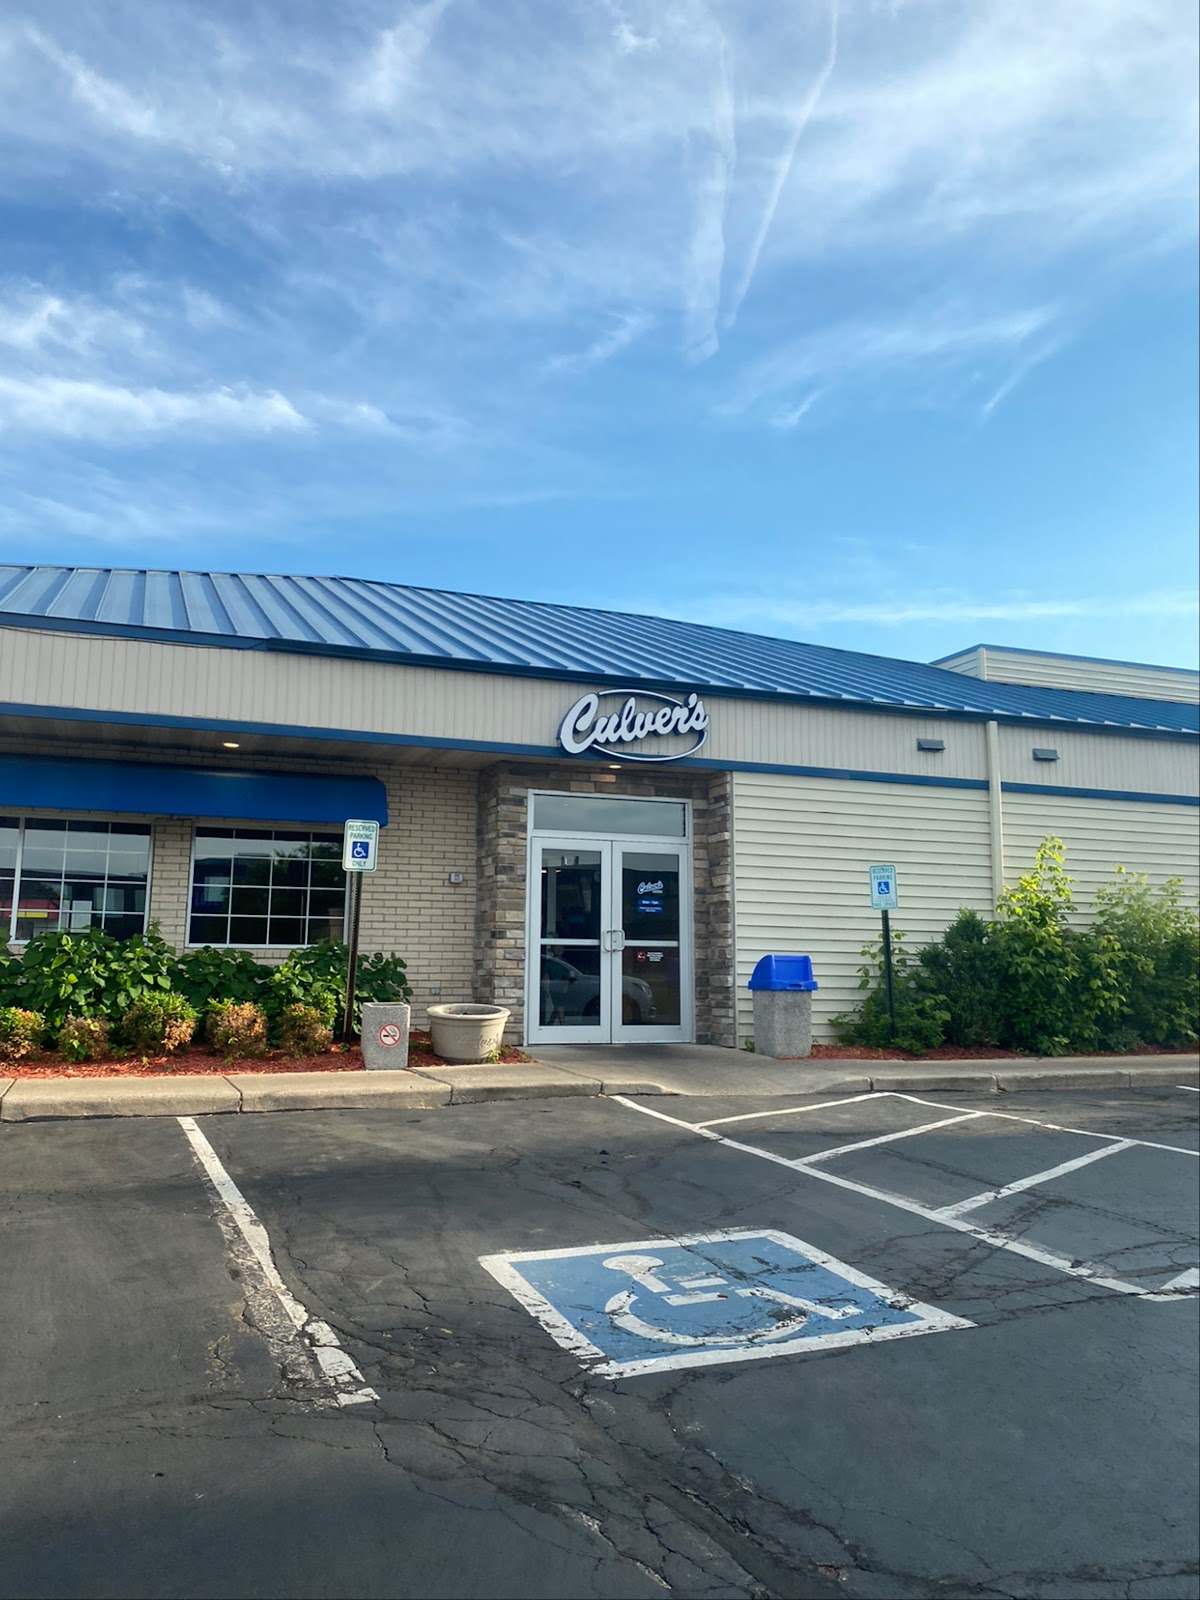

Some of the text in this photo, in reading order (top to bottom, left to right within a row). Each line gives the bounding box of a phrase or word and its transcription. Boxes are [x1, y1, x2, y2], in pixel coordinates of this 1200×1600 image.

[560, 692, 709, 754] Culver's
[348, 824, 376, 832] RESERVED
[350, 832, 373, 840] PARKING
